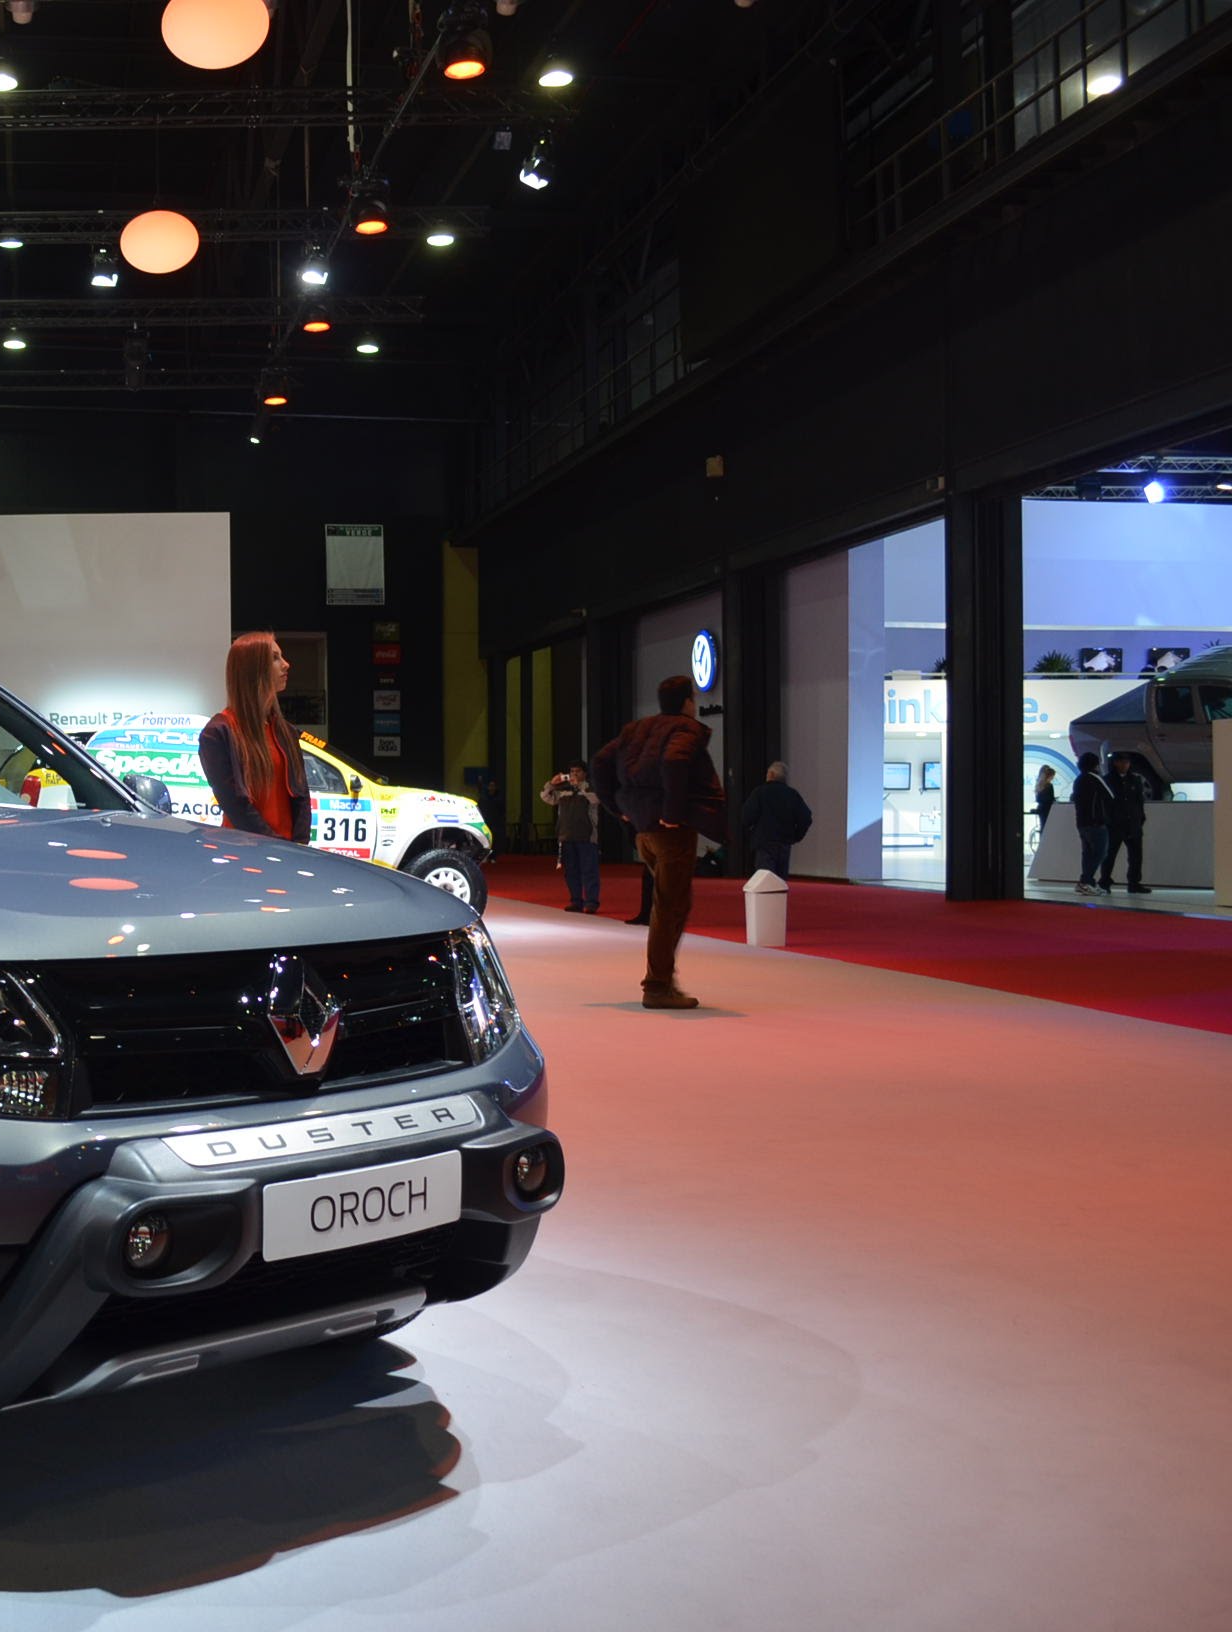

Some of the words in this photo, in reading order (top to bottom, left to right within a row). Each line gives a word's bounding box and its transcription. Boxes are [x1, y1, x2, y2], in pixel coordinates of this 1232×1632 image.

[49, 711, 108, 726] Renault
[884, 688, 946, 724] ink
[300, 731, 326, 749] FRAM
[96, 749, 206, 778] SpeedA
[171, 802, 222, 816] CACIQ
[329, 799, 362, 811] Macro
[323, 817, 367, 842] 316
[207, 1107, 456, 1157] DUSTER
[310, 1176, 428, 1233] OROCH
